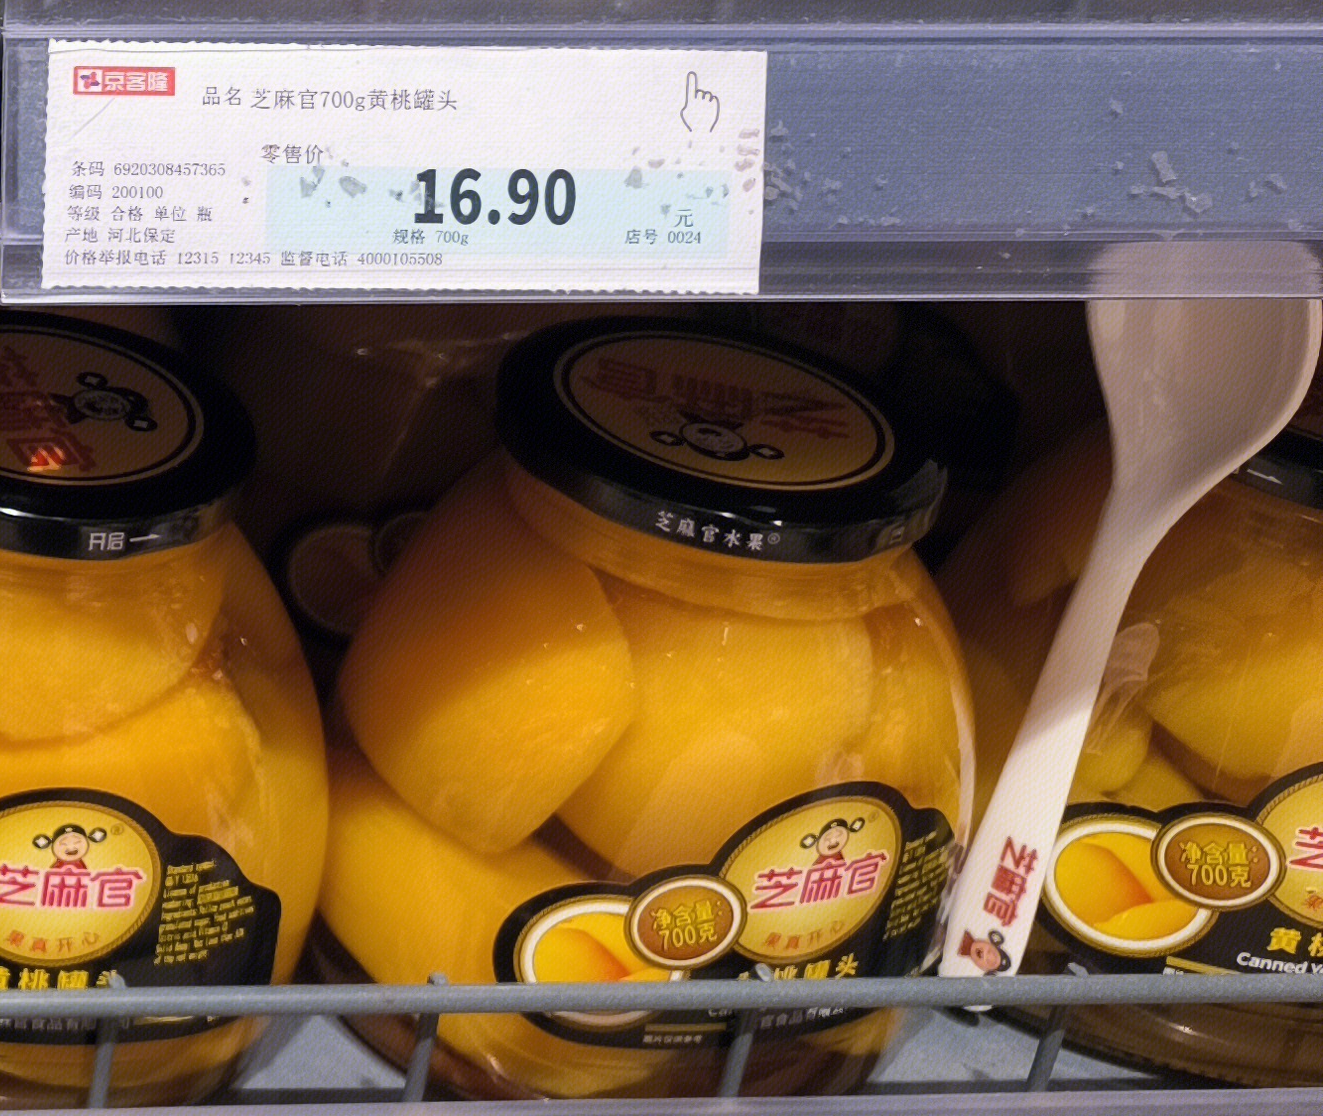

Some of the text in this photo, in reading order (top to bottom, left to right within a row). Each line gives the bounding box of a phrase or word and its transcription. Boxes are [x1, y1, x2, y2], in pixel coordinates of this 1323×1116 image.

[104, 71, 169, 92] 京客隆
[202, 86, 458, 112] 品名 芝麻官700g黄桃罐头
[260, 144, 324, 164] 零售价
[71, 161, 226, 177] 条码 6920308457365
[69, 184, 164, 201] 编码 200100
[414, 168, 576, 225] 16.90
[67, 206, 214, 223] 等级 合格 单位 瓶
[674, 209, 695, 227] 元
[65, 228, 175, 244] 产地 河北保定
[392, 229, 470, 246] 规格 700g
[624, 229, 702, 245] 店号 0024
[65, 250, 443, 267] 价格举报电话 12315 12345 监督电话 4000105508
[655, 510, 764, 552] 芝麻官水果
[753, 852, 890, 910] 芝麻官
[983, 836, 1039, 927] 芝麻官
[1186, 864, 1252, 888] 700克
[660, 921, 719, 951] 700克
[1236, 951, 1295, 974] Canned
